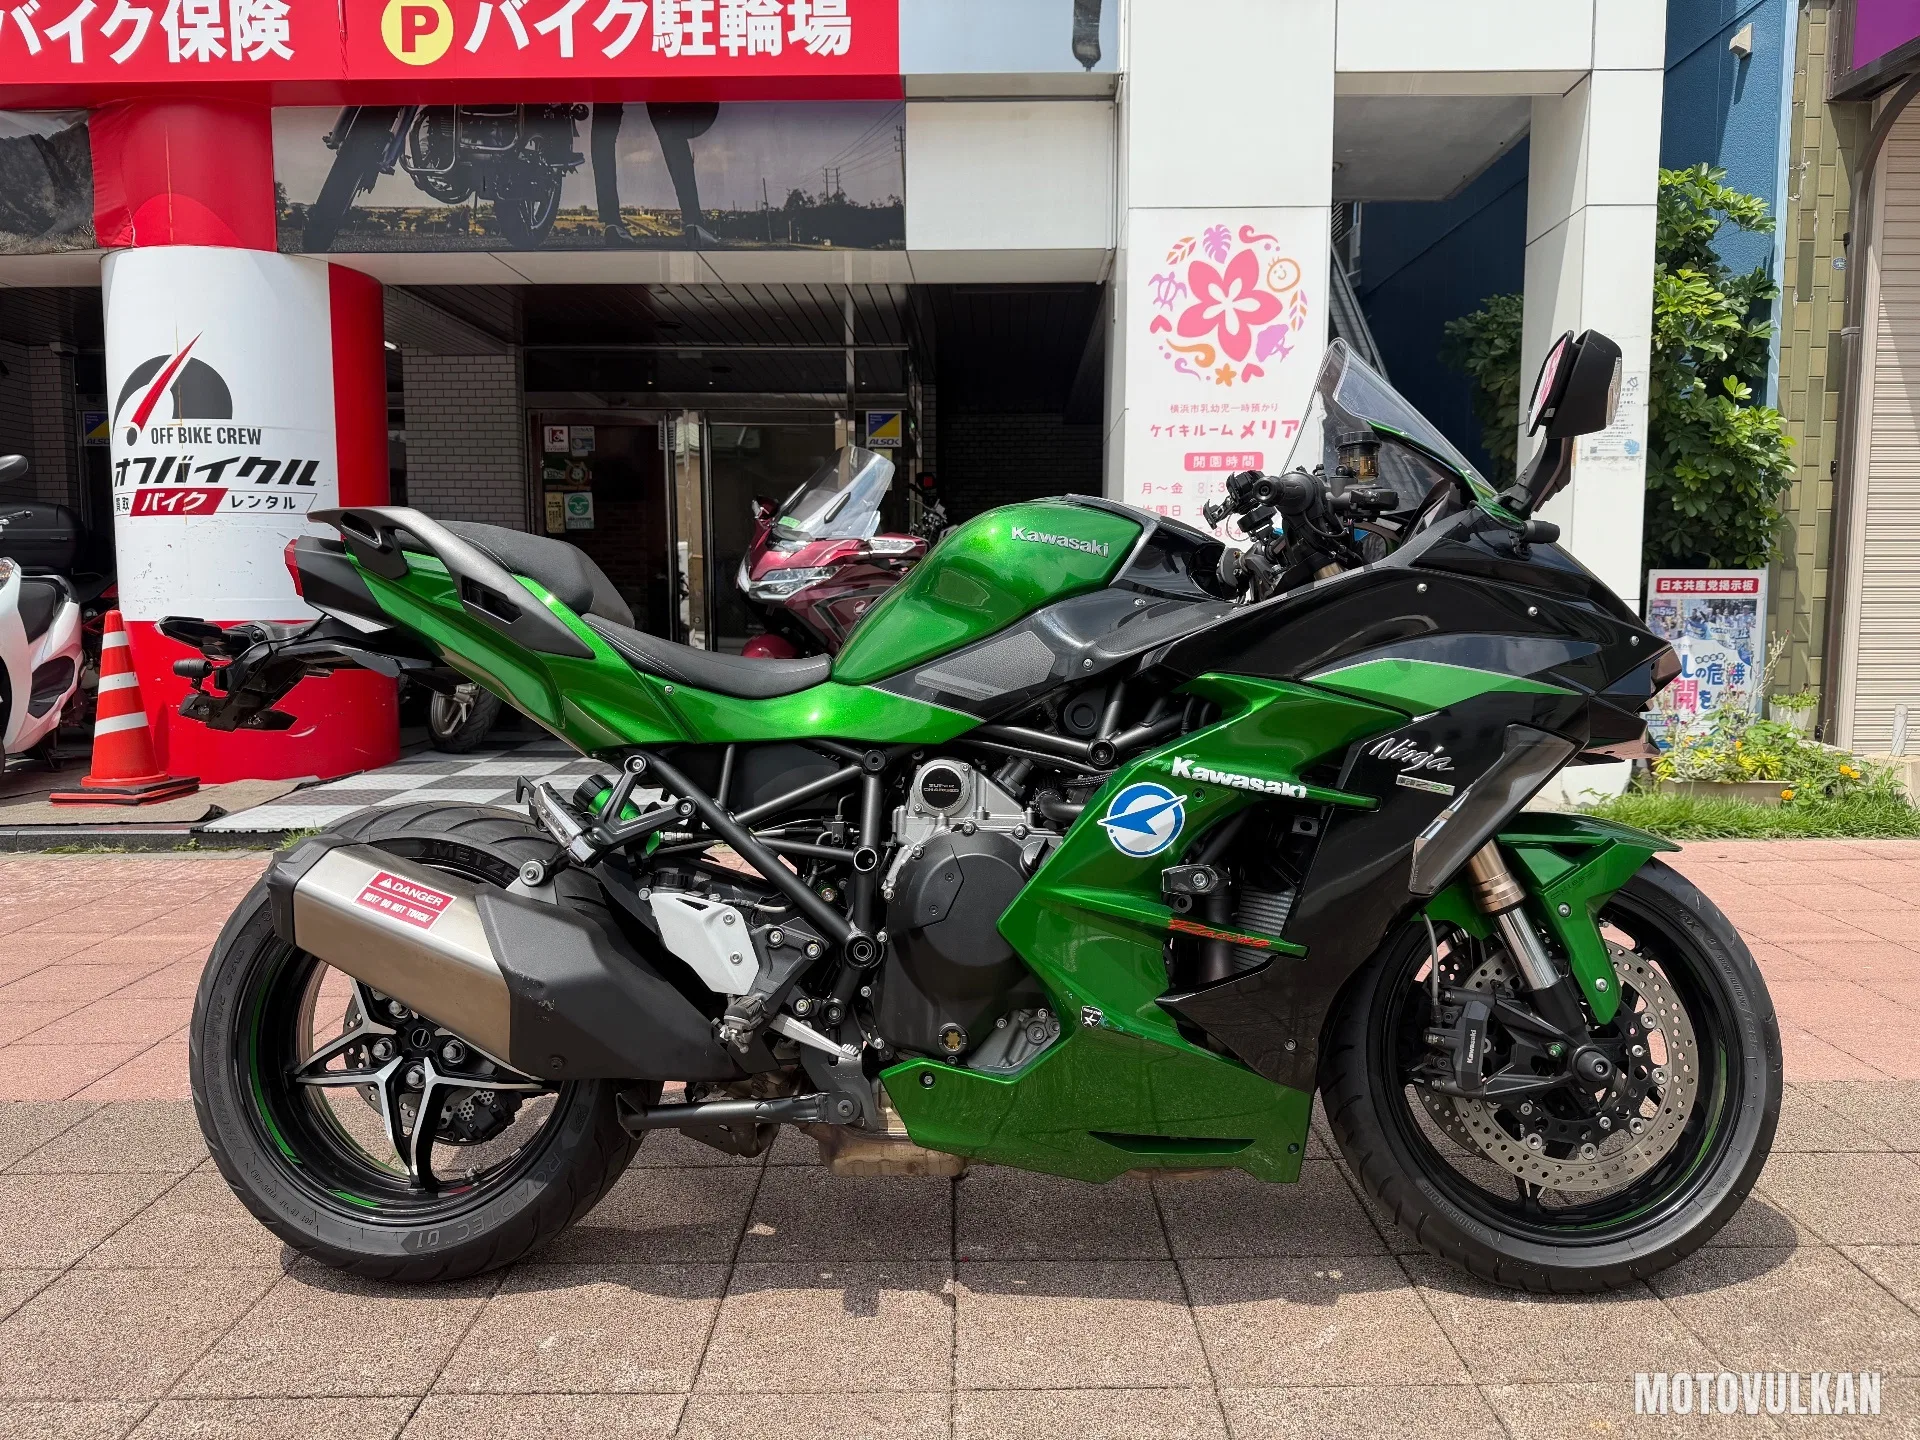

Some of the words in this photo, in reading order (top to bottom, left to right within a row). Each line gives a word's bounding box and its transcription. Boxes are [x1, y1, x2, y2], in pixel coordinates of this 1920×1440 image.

[0, 0, 294, 63] バイク保険
[401, 4, 440, 53] P
[464, 0, 852, 59] バイク駐輪場
[1169, 403, 1279, 414] 横浜市乳幼児一時預かり
[151, 427, 174, 445] OFF
[178, 427, 212, 444] BIKE
[216, 427, 262, 445] CREW
[869, 438, 900, 446] ALSOK
[1150, 424, 1234, 438] ケイキルーム
[1240, 419, 1300, 440] メリア
[114, 455, 320, 488] オフバイクル
[1192, 455, 1255, 468] 開園時間
[141, 491, 208, 513] バイク
[231, 495, 296, 510] レンタル
[1011, 526, 1110, 559] Kawasaki
[1660, 579, 1754, 591] 日本共産党掲示板
[1368, 737, 1455, 772] Ninja
[1170, 756, 1307, 799] Kawasaki
[392, 883, 444, 907] DANGER
[1466, 1029, 1477, 1064] Kawasaki
